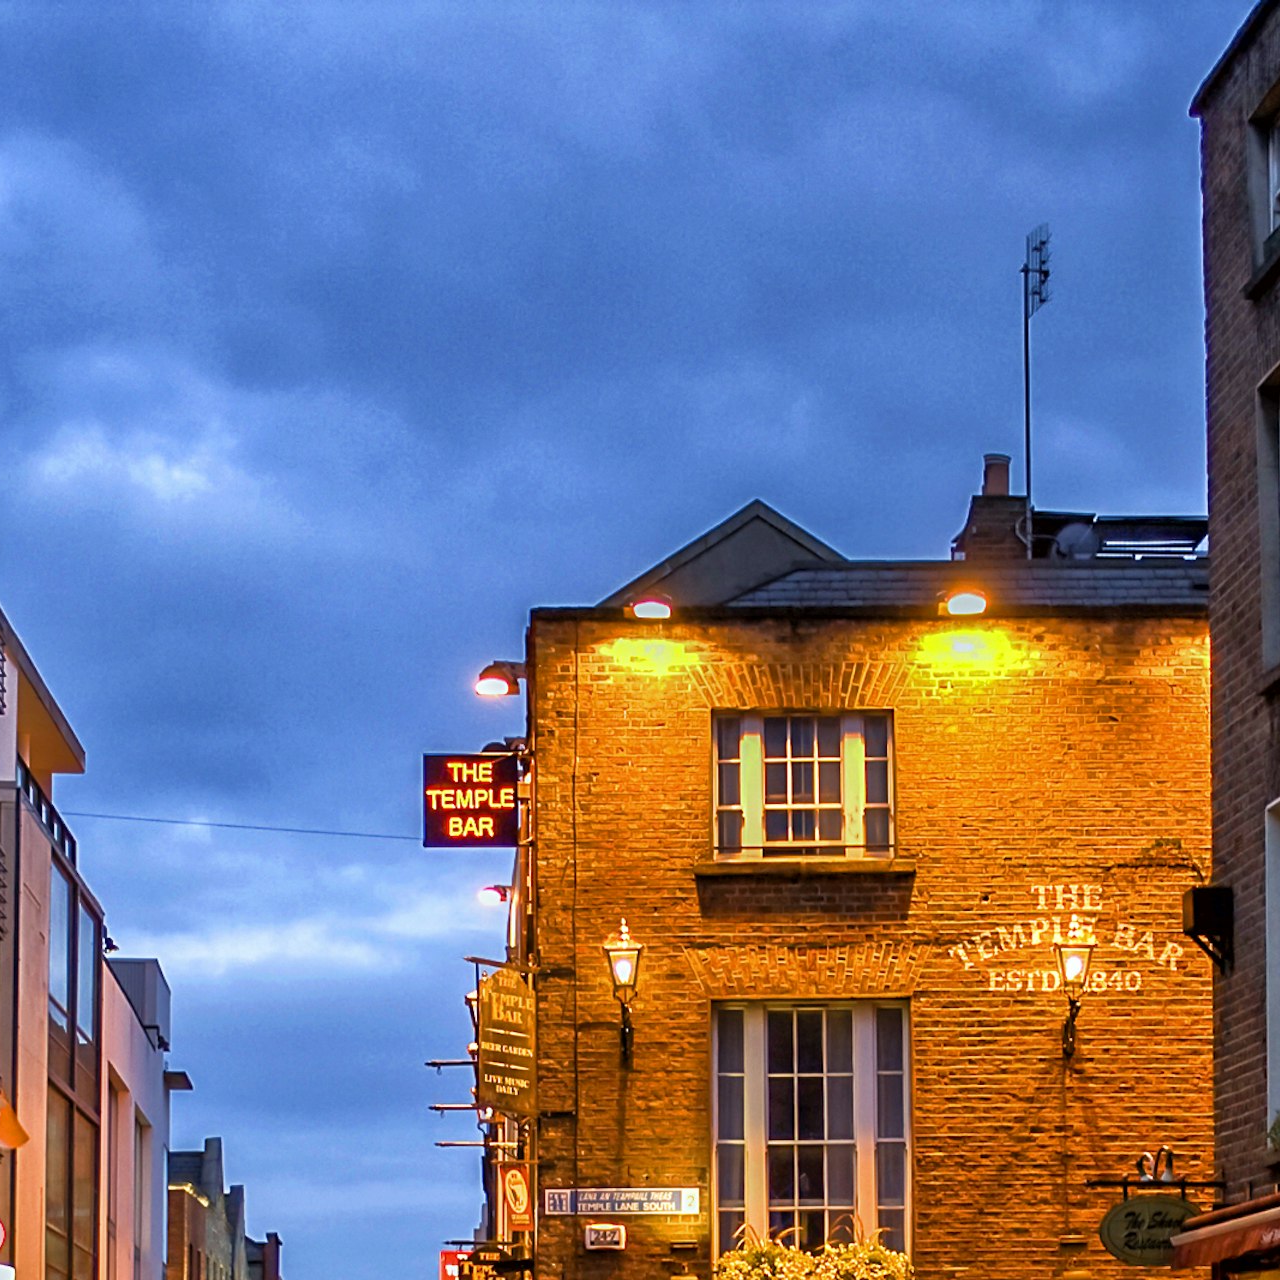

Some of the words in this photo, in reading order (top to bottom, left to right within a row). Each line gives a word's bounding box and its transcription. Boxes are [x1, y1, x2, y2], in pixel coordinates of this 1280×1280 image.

[446, 762, 493, 783] THE
[426, 788, 515, 810] TEMPLE
[449, 817, 494, 837] BAR
[1031, 884, 1103, 911] THE
[948, 916, 1099, 970] TEMPLE
[1110, 922, 1184, 972] BAR
[1083, 970, 1142, 992] 840
[491, 1000, 523, 1024] BAR
[481, 1041, 502, 1053] BEER
[484, 1073, 503, 1084] LIVE
[505, 1075, 531, 1089] MUSIC
[578, 1202, 611, 1211] TEMPLE
[614, 1202, 639, 1211] LANE
[642, 1201, 676, 1211] SOUTH
[1124, 1211, 1146, 1229] The
